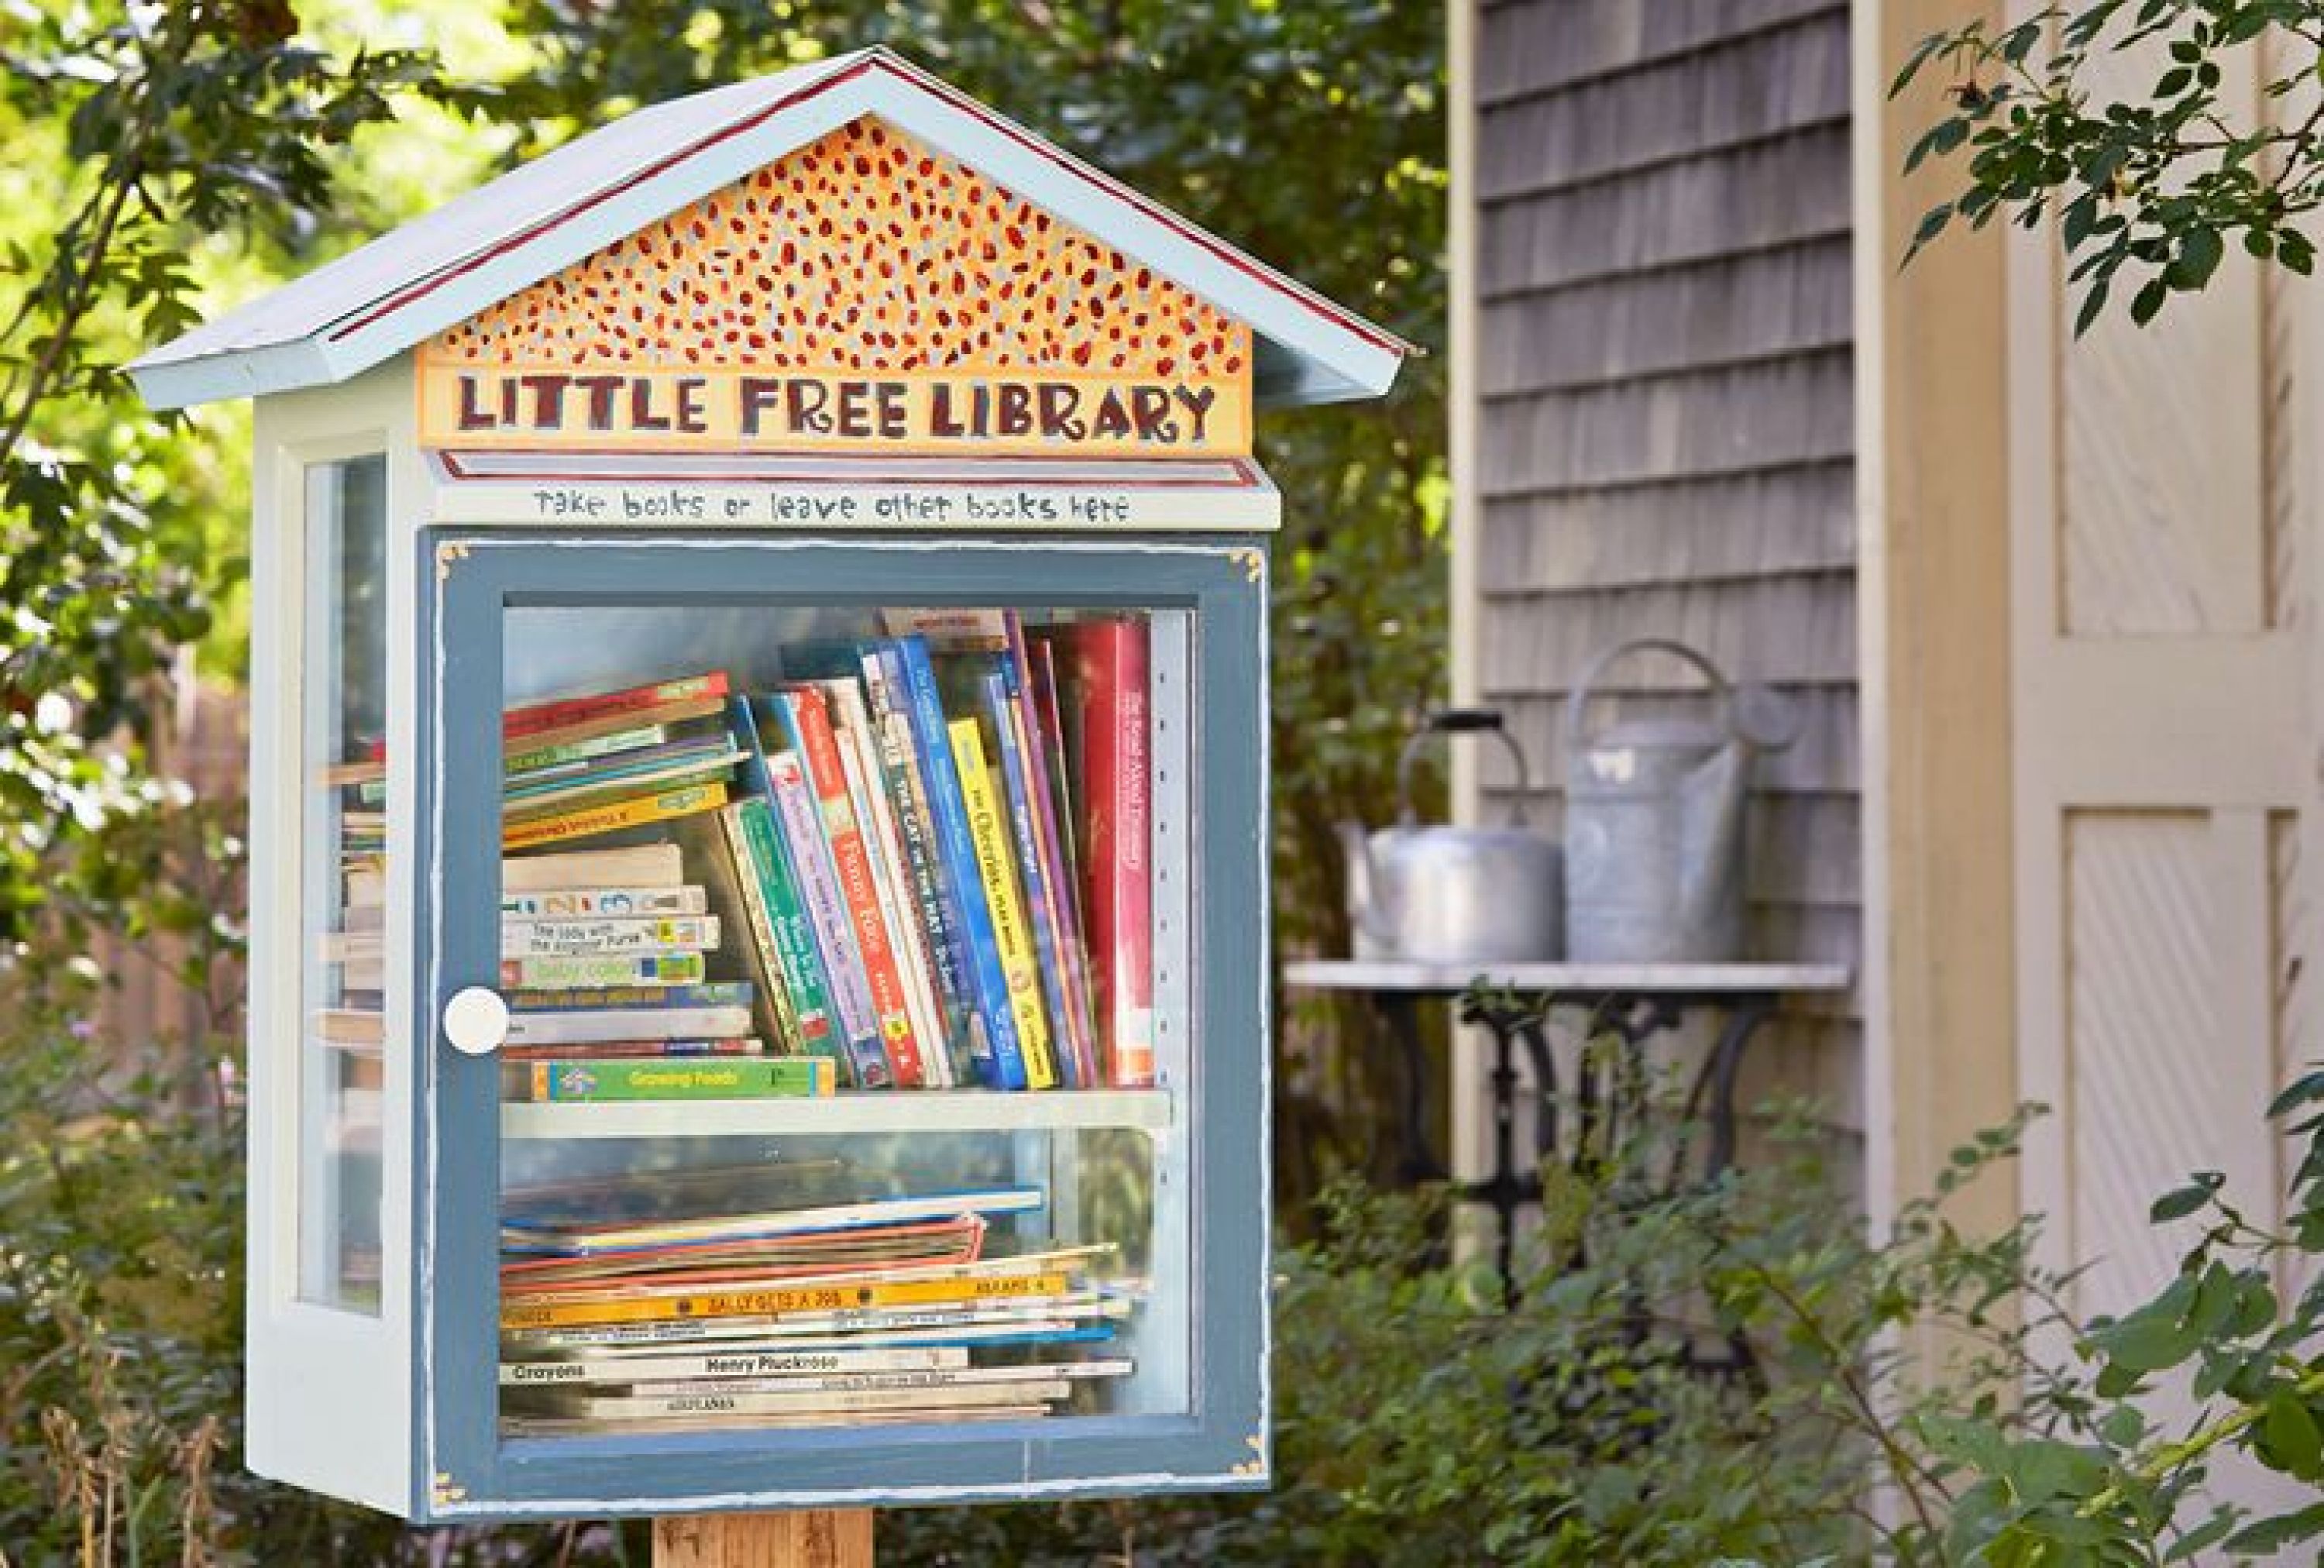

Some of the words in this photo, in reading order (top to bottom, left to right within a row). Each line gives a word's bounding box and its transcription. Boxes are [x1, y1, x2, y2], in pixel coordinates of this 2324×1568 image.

[459, 376, 707, 432] LITTLE
[739, 377, 908, 437] FREE
[930, 382, 1215, 443] LIBRARY
[621, 489, 705, 518] books
[722, 498, 751, 518] or
[771, 492, 857, 521] leave
[875, 492, 954, 522] other
[966, 492, 1058, 520] books
[1069, 493, 1131, 523] here
[512, 1364, 586, 1382] Crayons
[707, 1358, 754, 1374] Henry
[758, 1356, 838, 1370] Pluckrose
